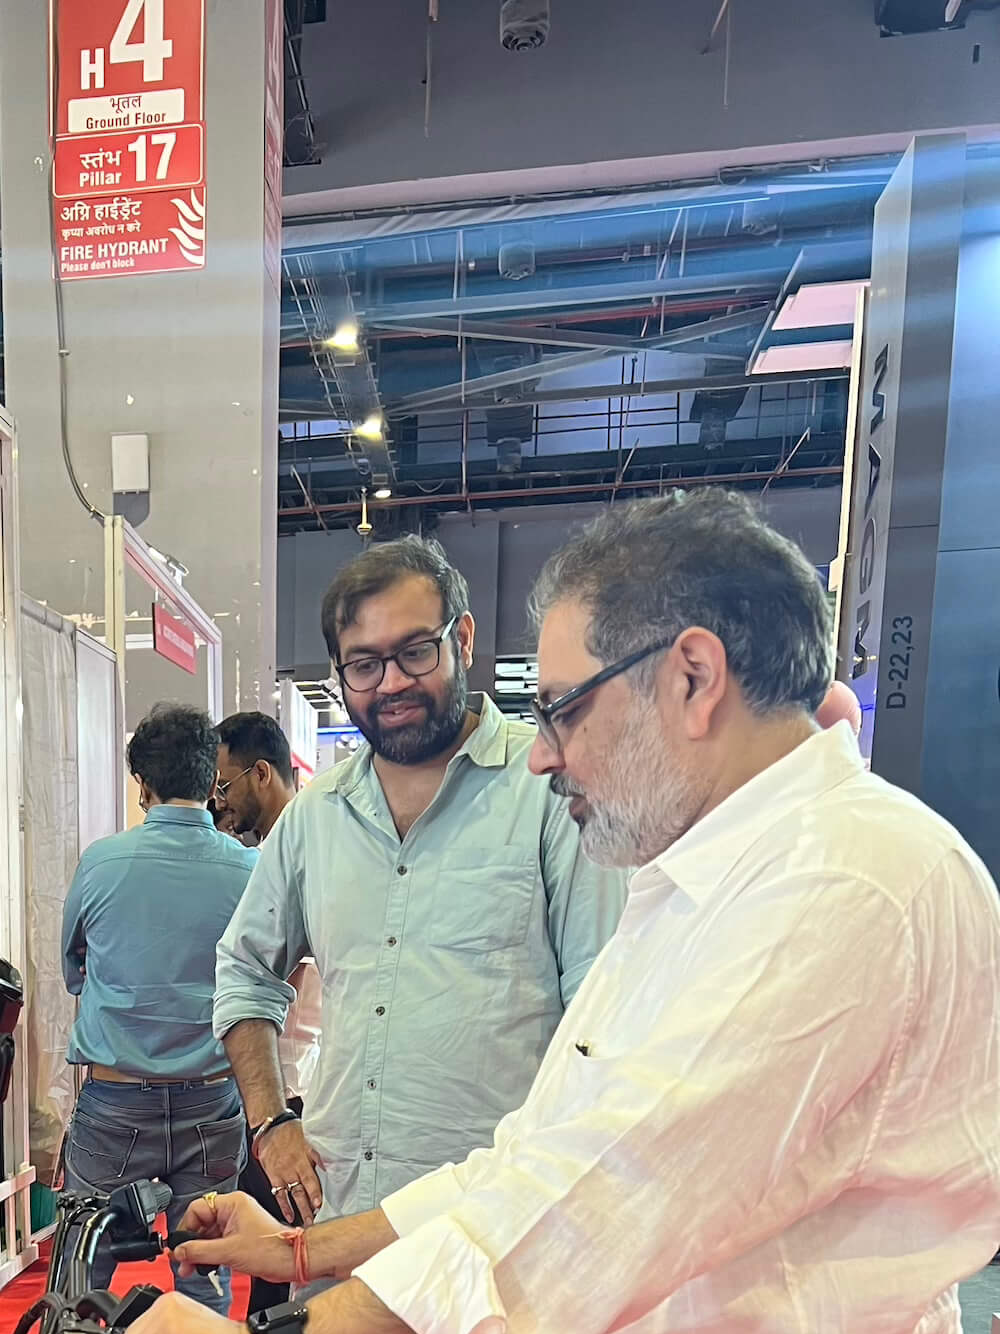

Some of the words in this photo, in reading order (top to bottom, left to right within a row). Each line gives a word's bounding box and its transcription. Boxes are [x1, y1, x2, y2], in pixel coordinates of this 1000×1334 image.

[80, 47, 104, 90] H
[109, 0, 173, 82] 4
[109, 95, 142, 113] भूतल
[86, 113, 130, 129] Ground
[135, 112, 167, 126] Floor
[79, 148, 122, 169] स्तंभ
[127, 132, 176, 182] 17
[79, 171, 122, 188] Pillar
[61, 245, 94, 261] FIRE
[98, 238, 169, 259] HYDRANT
[61, 261, 89, 273] Please
[90, 260, 111, 271] don't
[112, 257, 135, 269] block
[886, 615, 915, 710] D-22,23
